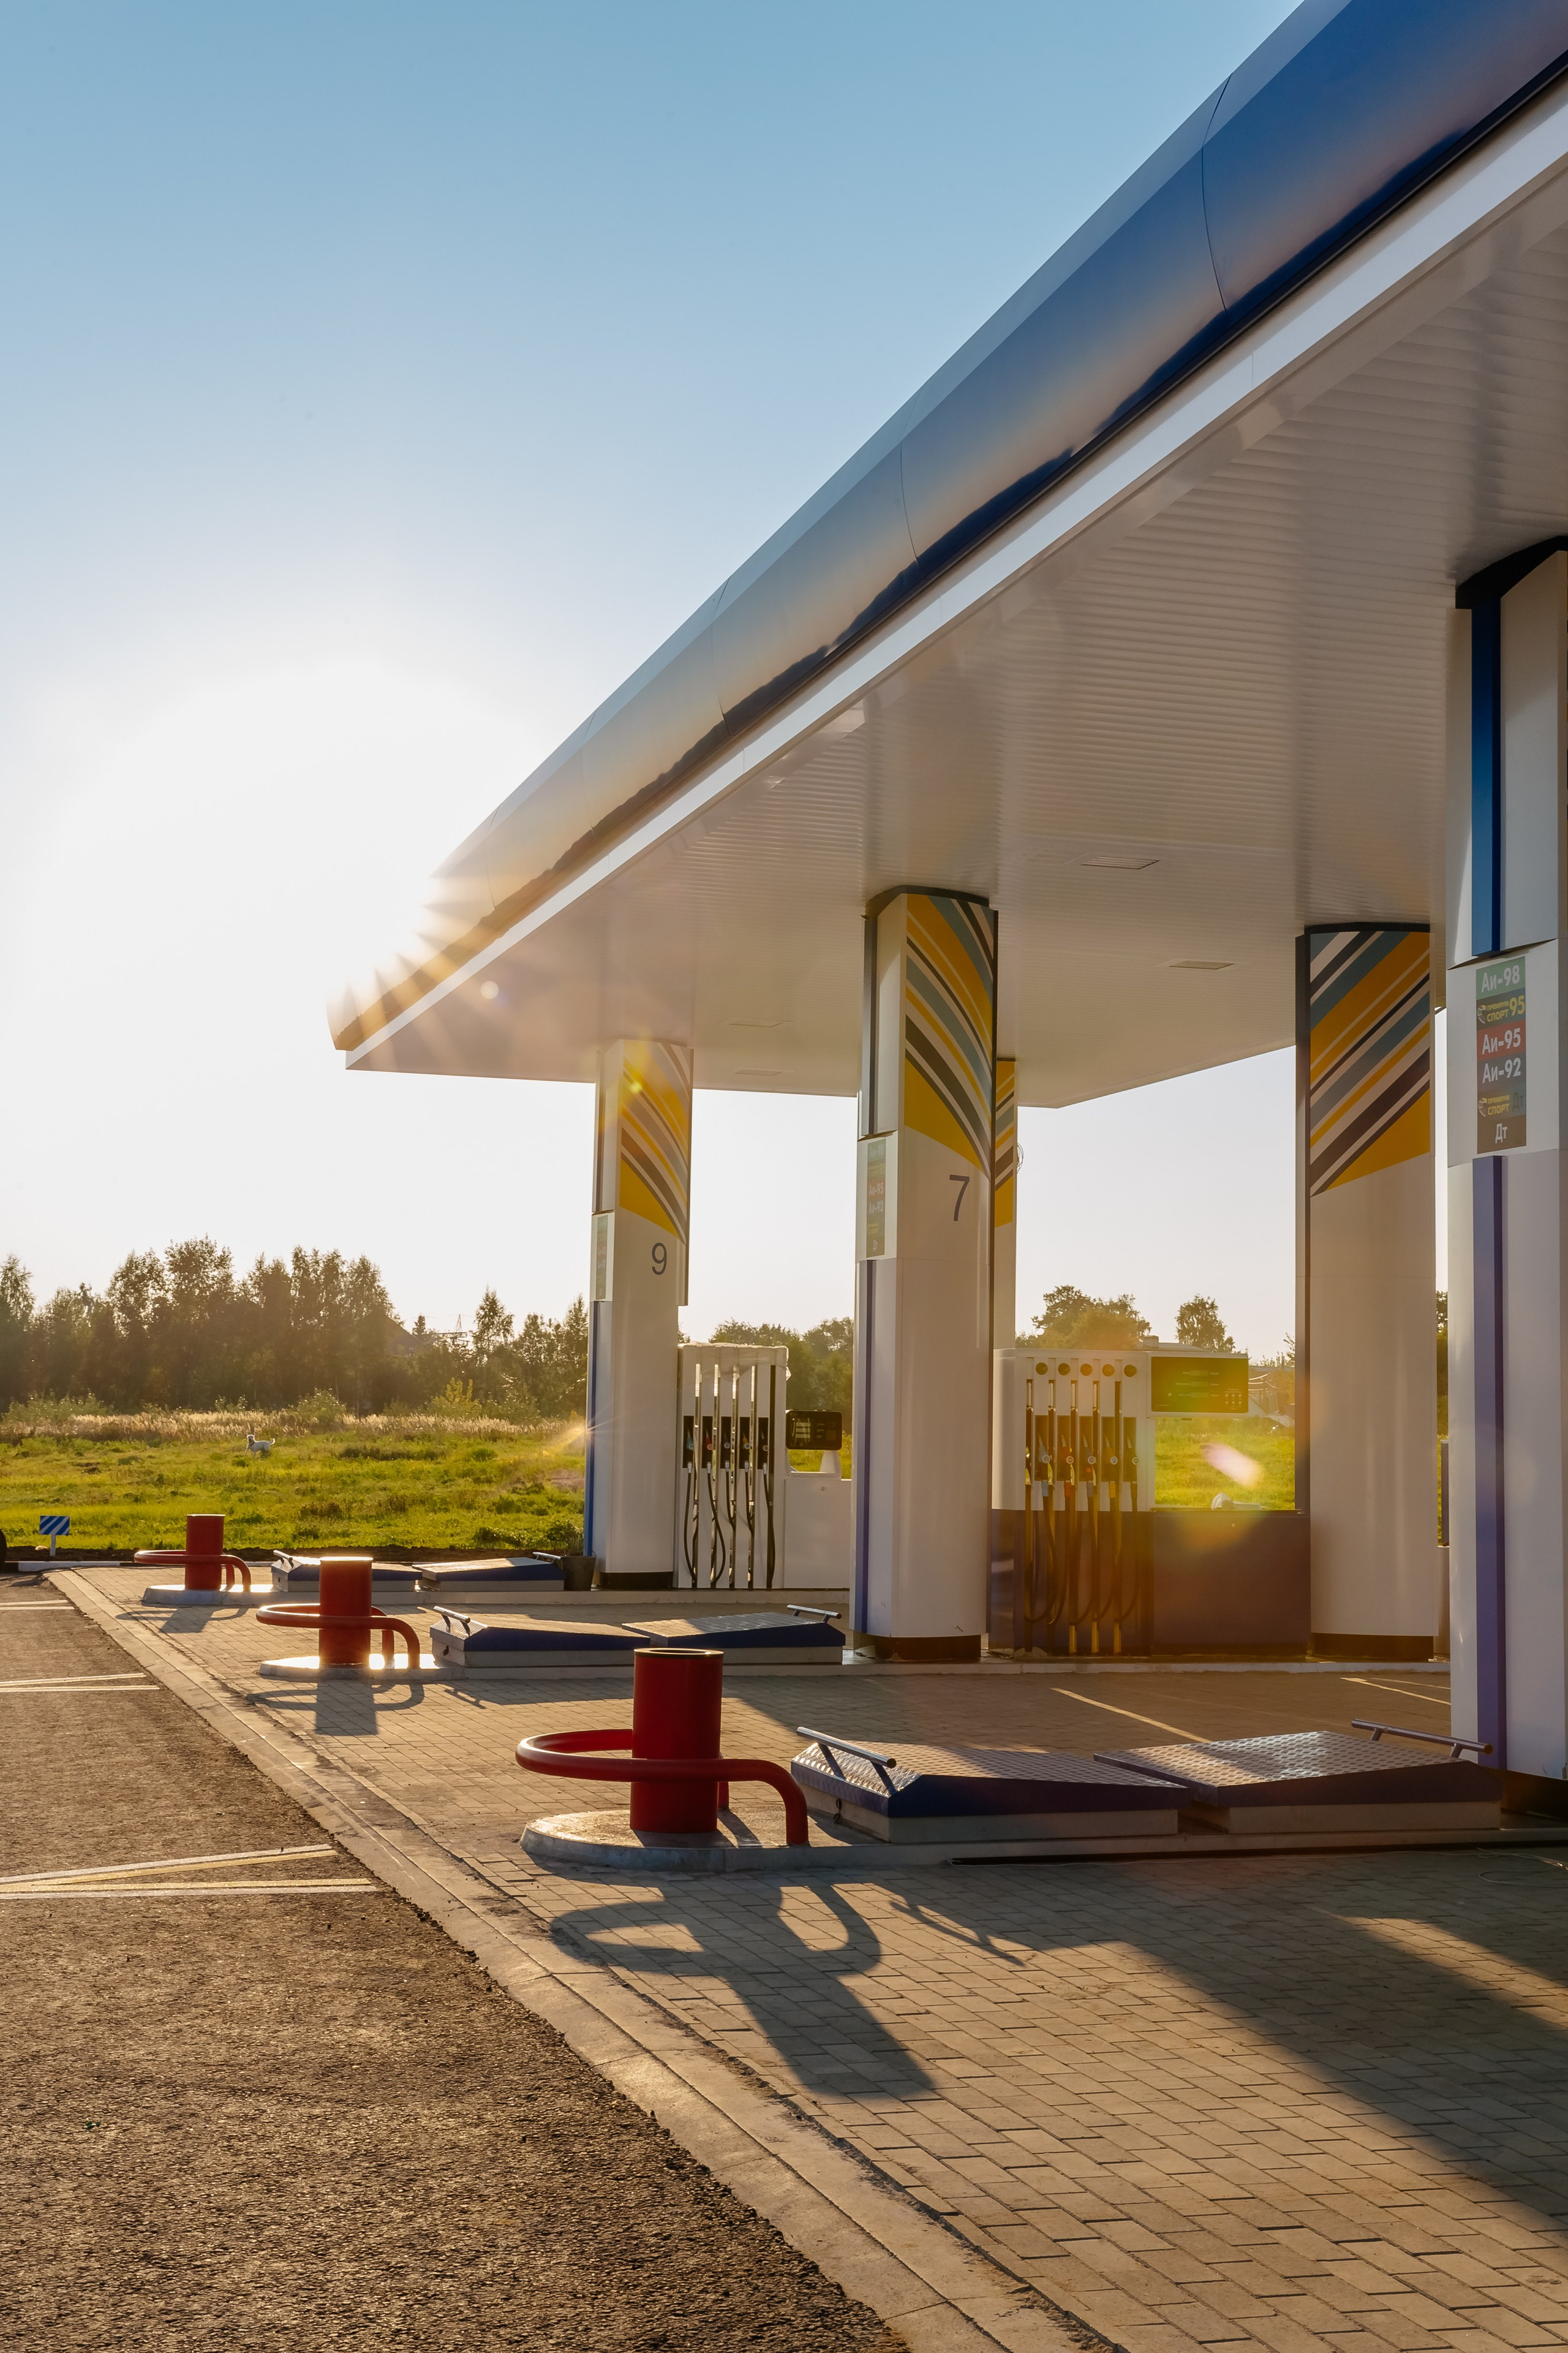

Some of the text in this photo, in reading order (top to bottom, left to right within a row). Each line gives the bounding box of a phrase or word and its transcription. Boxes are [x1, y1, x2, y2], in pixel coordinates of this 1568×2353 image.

[1481, 965, 1520, 992] Аи-98
[1487, 1000, 1509, 1011] ПРЕМИУМ
[1487, 1009, 1509, 1022] СПОРТ
[1509, 995, 1525, 1016] 95
[1482, 1028, 1521, 1054] Аи-95
[1482, 1057, 1521, 1084] Аи-92
[1487, 1094, 1510, 1104] ПРЕМИУМ
[1487, 1103, 1510, 1116] СПОРТ
[1495, 1123, 1507, 1144] Дт
[949, 1174, 970, 1222] 7
[652, 1242, 668, 1275] 9
